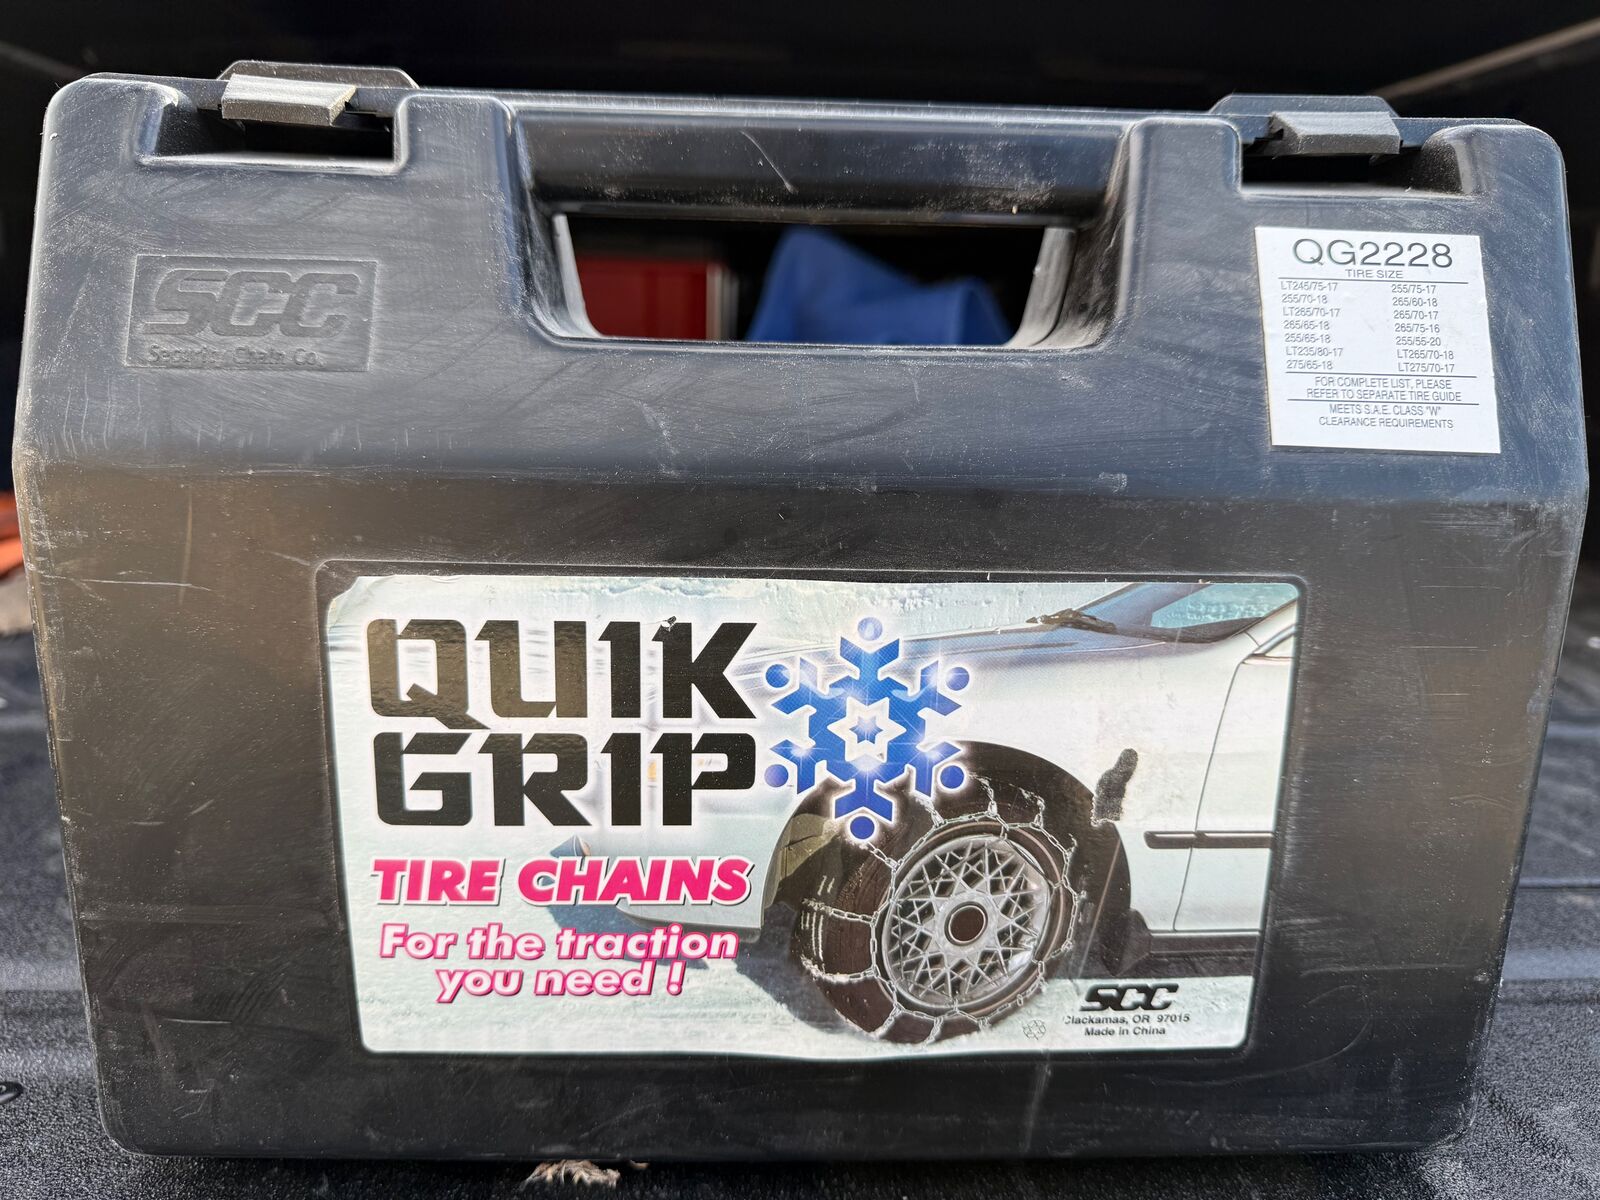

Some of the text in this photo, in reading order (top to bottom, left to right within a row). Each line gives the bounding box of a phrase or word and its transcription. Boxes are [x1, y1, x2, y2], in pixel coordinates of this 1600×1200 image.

[1293, 238, 1453, 268] QG2228
[1345, 269, 1404, 279] TIRE SIZE
[1281, 281, 1337, 291] LT245/75-17
[1392, 284, 1436, 293] 255/75-17
[142, 268, 361, 337] SCC
[1282, 294, 1328, 304] 255/70-18
[1392, 297, 1437, 307] 265/60-18
[1393, 310, 1438, 320] 265/70-17
[1395, 323, 1440, 333] 265/75-16
[1396, 336, 1441, 346] 255/55-20
[1397, 349, 1454, 359] LT265/70-18
[1287, 360, 1333, 370] 275/65-18
[1398, 363, 1454, 372] LT275/70-17
[1315, 377, 1452, 389] FOR COMPLETE LIST, PLEASE
[1307, 388, 1462, 401] REFER TO SEPARATE TIRE GUIDE
[1329, 404, 1361, 414] MEETS
[1364, 405, 1390, 415] S.A.E.
[1393, 405, 1423, 415] CLASS
[1318, 417, 1454, 429] CLEARANCE REQUIREMENTS
[367, 618, 757, 730] QUIK
[373, 731, 757, 826] GRIP
[371, 855, 753, 906] TIRE CHAINS
[380, 922, 740, 960] For the traction
[436, 960, 687, 1004] you need !
[1079, 983, 1179, 1011] SCC
[1132, 1015, 1150, 1023] OR
[1157, 1014, 1190, 1023] 97015
[1084, 1027, 1166, 1036] Made in China
